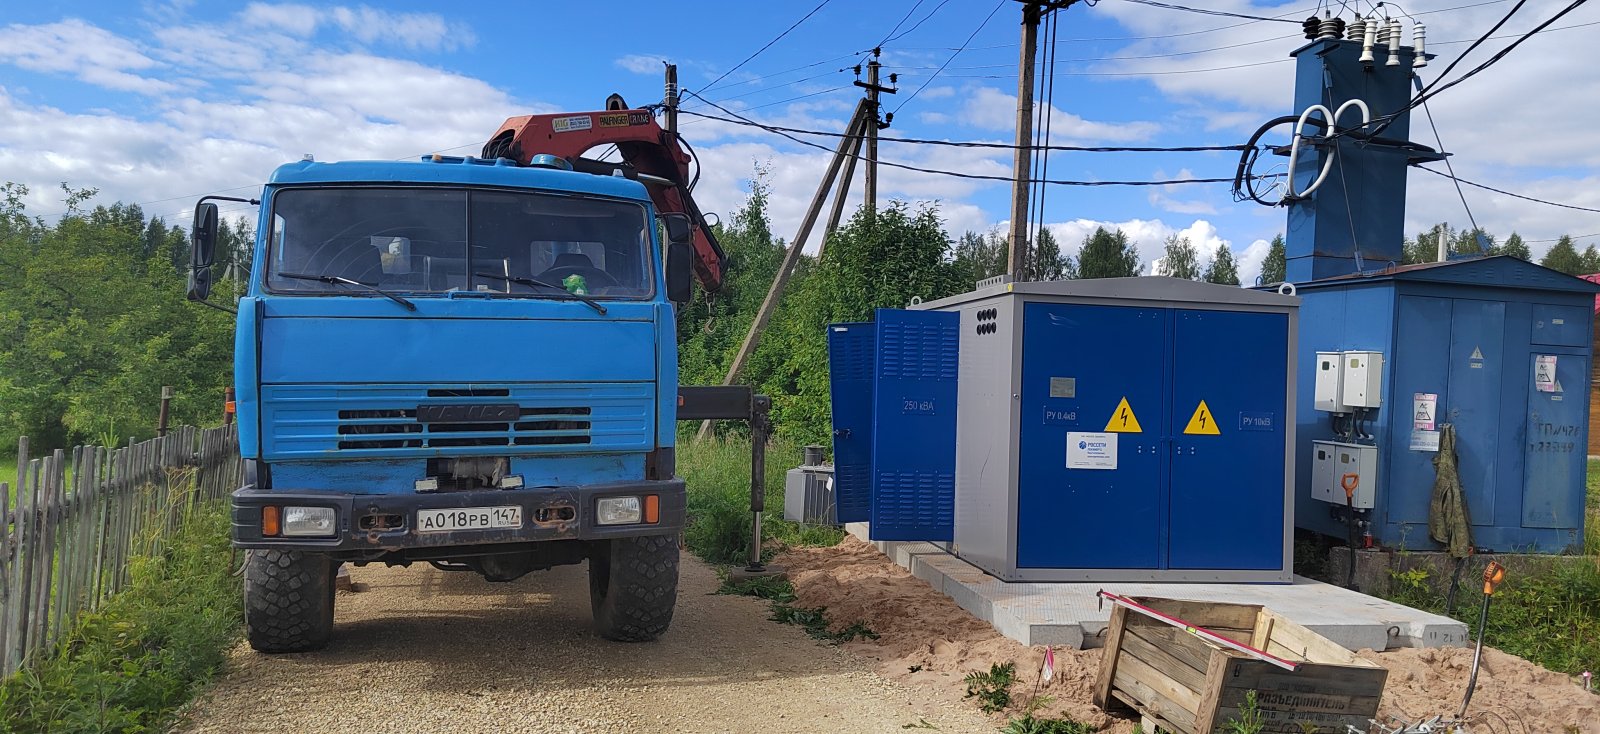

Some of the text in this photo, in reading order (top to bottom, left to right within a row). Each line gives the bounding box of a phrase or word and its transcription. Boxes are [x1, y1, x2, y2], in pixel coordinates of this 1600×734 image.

[904, 400, 918, 410] 250
[1046, 411, 1057, 420] РУ
[1243, 417, 1253, 426] РУ
[424, 508, 517, 529] А018РВ 147
